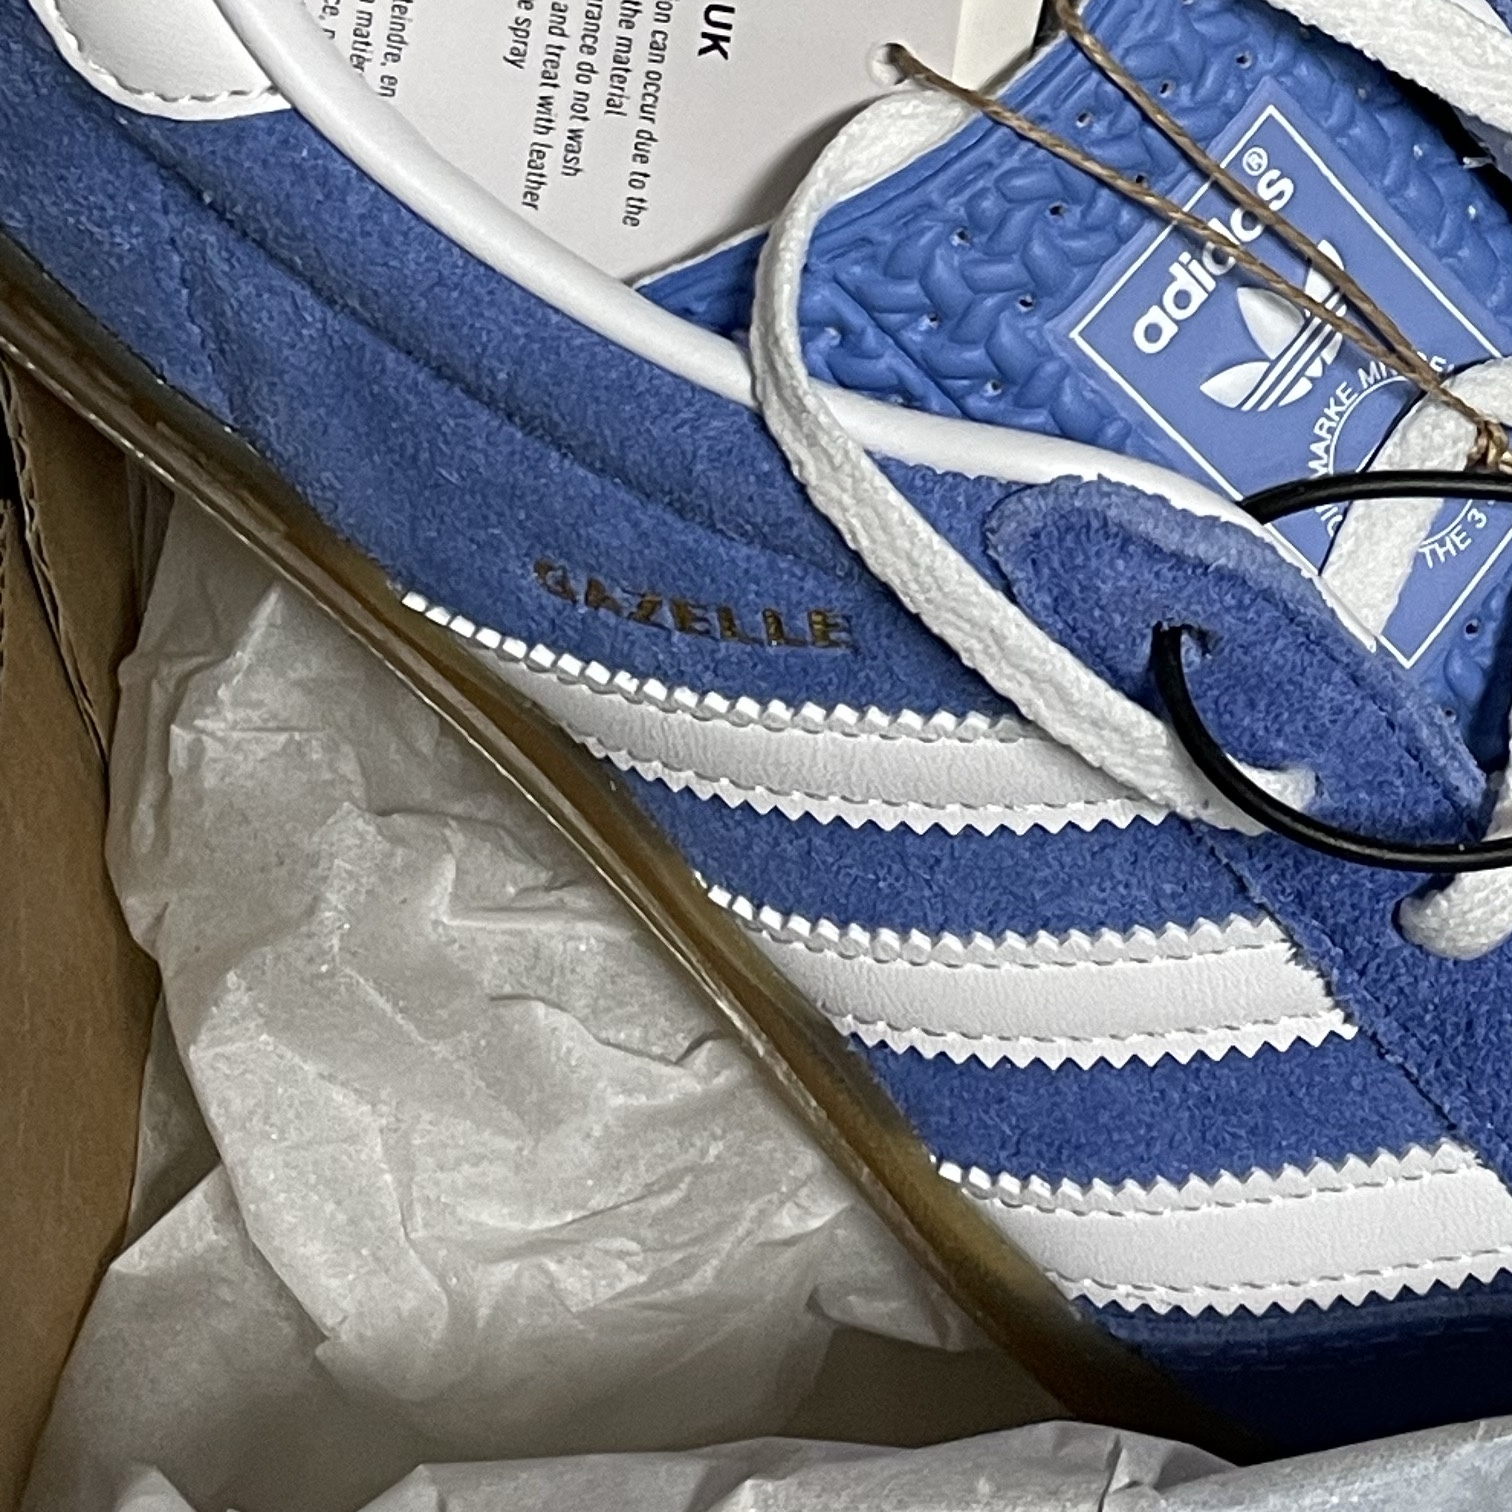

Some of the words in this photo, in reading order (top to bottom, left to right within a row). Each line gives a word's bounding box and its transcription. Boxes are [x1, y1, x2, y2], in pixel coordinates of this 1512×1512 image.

[548, 1, 571, 39] and
[618, 0, 643, 30] the
[697, 3, 736, 61] UK
[350, 9, 374, 77] matièr
[503, 16, 532, 70] spray
[648, 29, 669, 64] can
[377, 74, 398, 97] en
[539, 44, 567, 89] treat
[575, 61, 600, 85] do
[604, 35, 633, 117] material
[533, 94, 558, 136] with
[569, 90, 591, 121] not
[639, 70, 663, 124] occur
[560, 127, 585, 177] wash
[632, 128, 659, 165] due
[521, 141, 554, 211] leather
[628, 170, 652, 191] to
[622, 196, 648, 228] the
[1357, 359, 1398, 389] MI
[1418, 524, 1472, 569] THE
[1467, 508, 1487, 529] 3
[532, 557, 858, 650] GAZELLE
